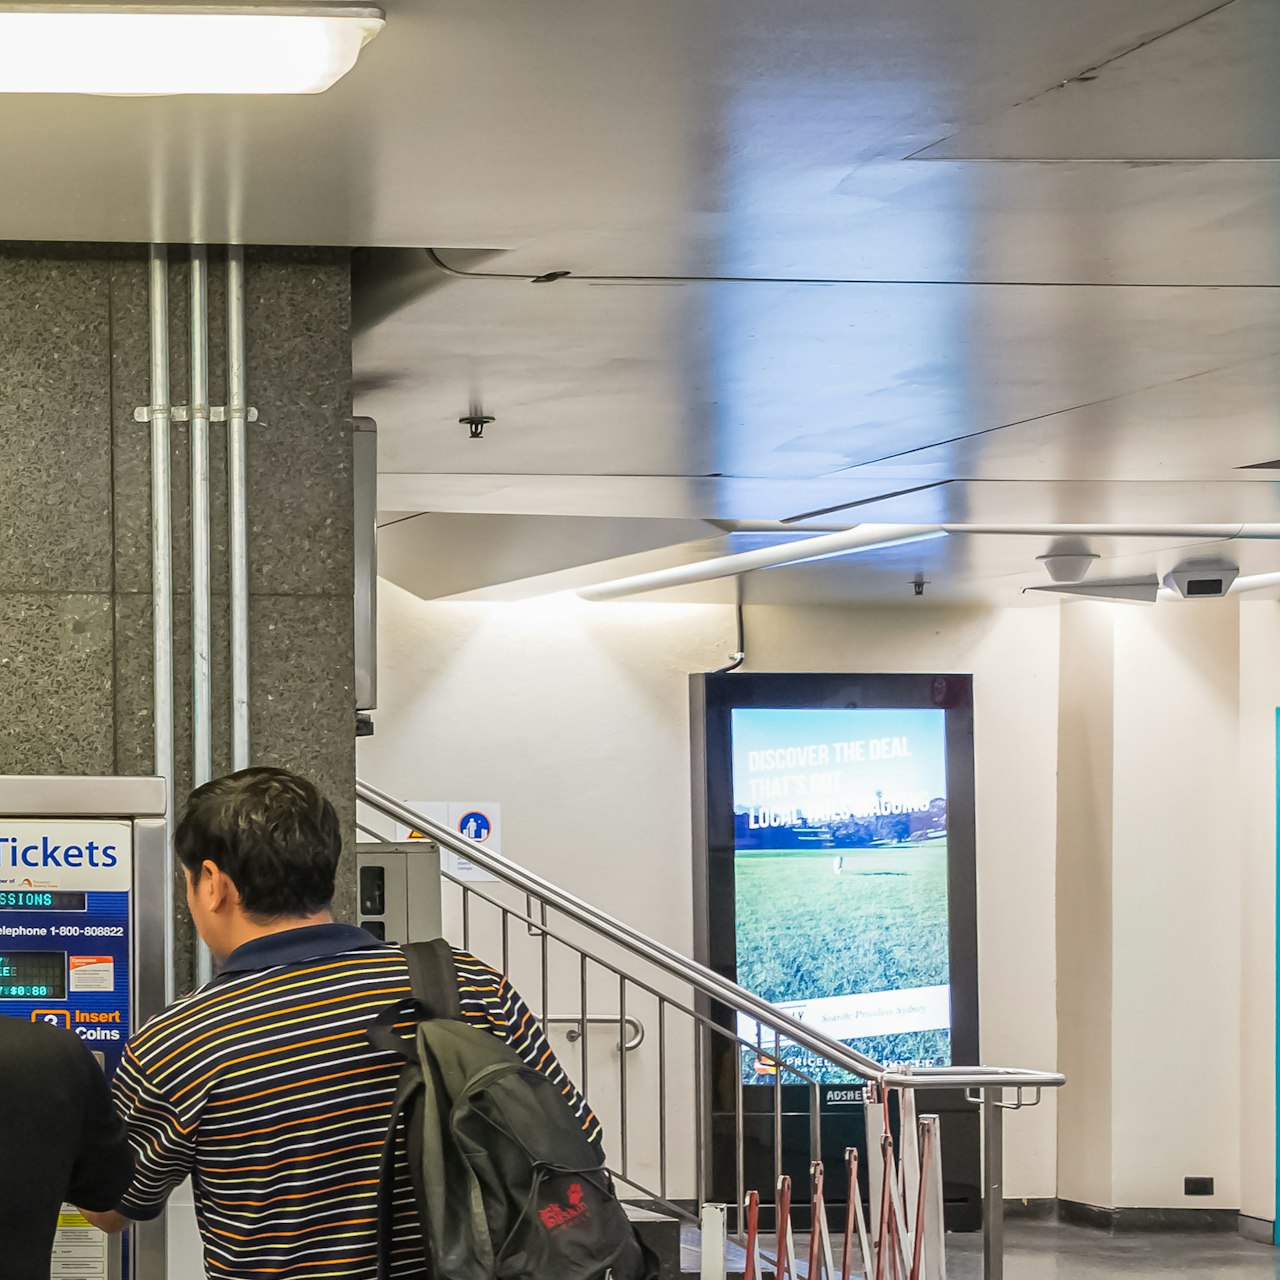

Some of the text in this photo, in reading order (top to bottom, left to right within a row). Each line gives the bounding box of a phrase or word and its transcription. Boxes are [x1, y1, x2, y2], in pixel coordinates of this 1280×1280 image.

[748, 736, 913, 772] DISCOVER THE DEAL
[748, 771, 843, 801] THAT'S GOT
[748, 806, 802, 830] LOCAL
[50, 926, 124, 937] 1-800-808822
[10, 986, 47, 996] $0.80
[75, 1010, 121, 1023] Insert
[75, 1027, 120, 1040] Coins
[786, 1057, 835, 1067] PRICEL
[826, 1090, 863, 1101] ADSHE
